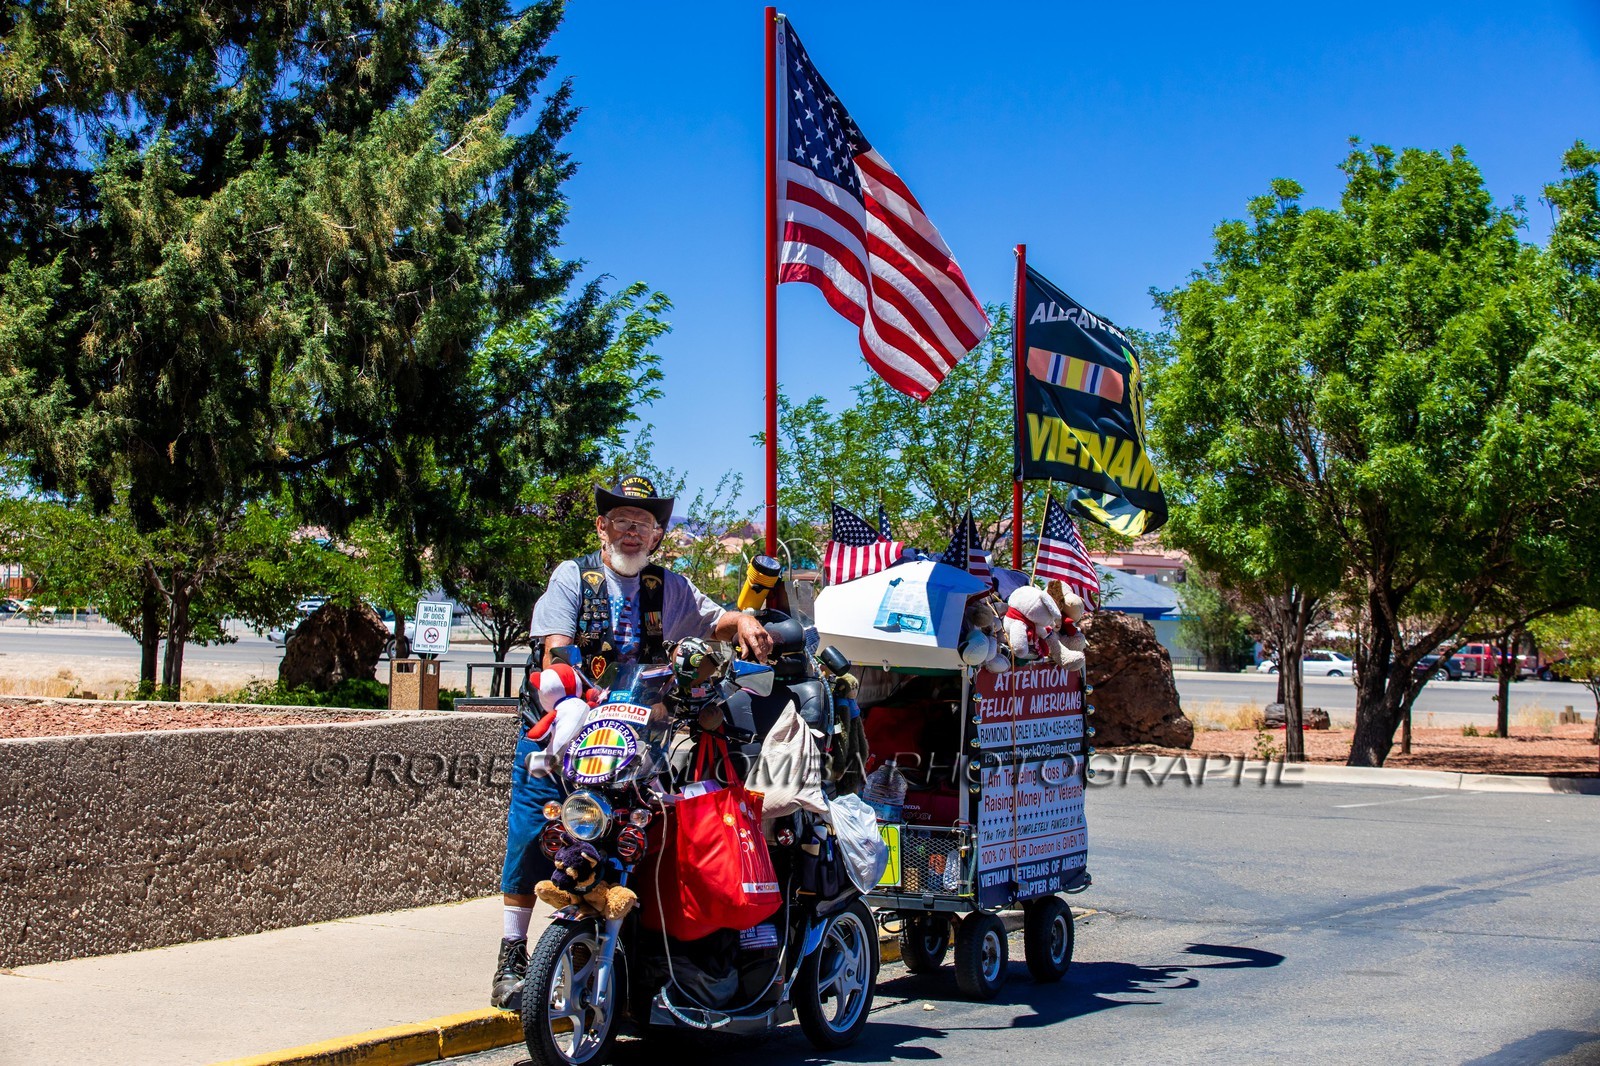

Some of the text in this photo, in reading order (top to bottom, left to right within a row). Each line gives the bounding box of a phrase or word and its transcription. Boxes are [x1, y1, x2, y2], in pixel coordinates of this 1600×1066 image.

[1029, 301, 1068, 325] ALL
[1027, 412, 1159, 493] VIETNAM
[621, 477, 654, 492] VIETNAM
[624, 491, 648, 499] VETERAN
[994, 668, 1069, 692] ATTENTION
[600, 704, 648, 717] PROUD
[980, 691, 1082, 718] FELLOW AMERICANS
[620, 713, 646, 722] VETERAN
[567, 720, 636, 755] VIETNAM VETERANS
[980, 726, 1009, 743] RAYMOND
[1034, 721, 1050, 738] BLACK
[578, 748, 623, 757] LIFE MEMBER
[987, 772, 1001, 788] Am
[1040, 764, 1060, 781] Cross
[984, 783, 1083, 813] Raising Money For Veterans
[995, 829, 1006, 840] Trip
[1016, 821, 1049, 836] COMPLETELY
[1050, 818, 1068, 830] FUNDED
[1069, 816, 1076, 826] BY
[1077, 814, 1083, 824] ME
[981, 850, 997, 865] 100%
[1009, 845, 1027, 859] YOUR
[1029, 841, 1055, 856] Donation
[1062, 836, 1077, 849] GIVEN
[1078, 833, 1086, 846] TO
[980, 853, 1087, 888] VIETNAM VETERANS OF AMERICA
